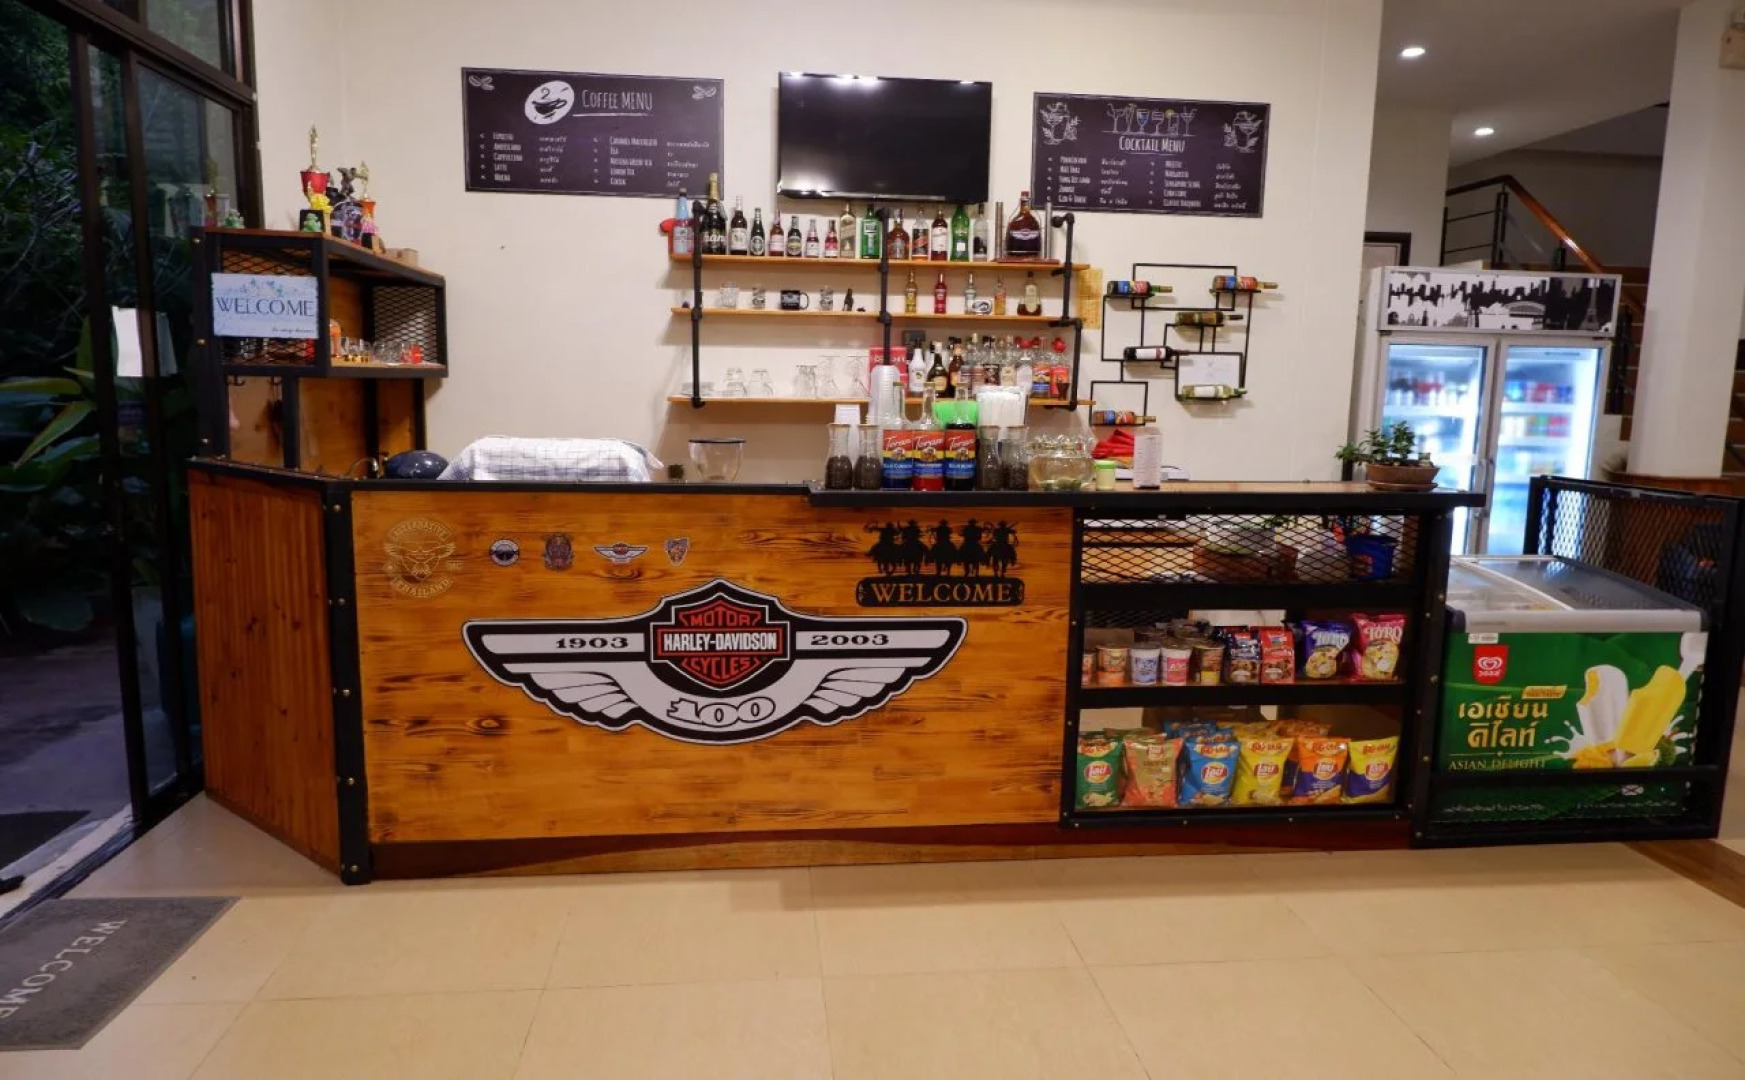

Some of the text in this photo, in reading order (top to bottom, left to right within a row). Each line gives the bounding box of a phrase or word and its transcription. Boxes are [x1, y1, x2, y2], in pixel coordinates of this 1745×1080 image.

[621, 91, 653, 111] MENU
[1119, 136, 1186, 153] COCKTAIL MENU
[215, 296, 316, 317] WELCOME
[870, 582, 1013, 603] WELCOME
[690, 606, 752, 627] MOTOR
[556, 636, 629, 649] 1903
[663, 632, 778, 651] HARLEY-DAVIDSON
[810, 633, 890, 646] 2003
[690, 657, 751, 680] CYCLES
[666, 696, 776, 728] 100
[1449, 759, 1545, 770] ASIAN DELIGHT
